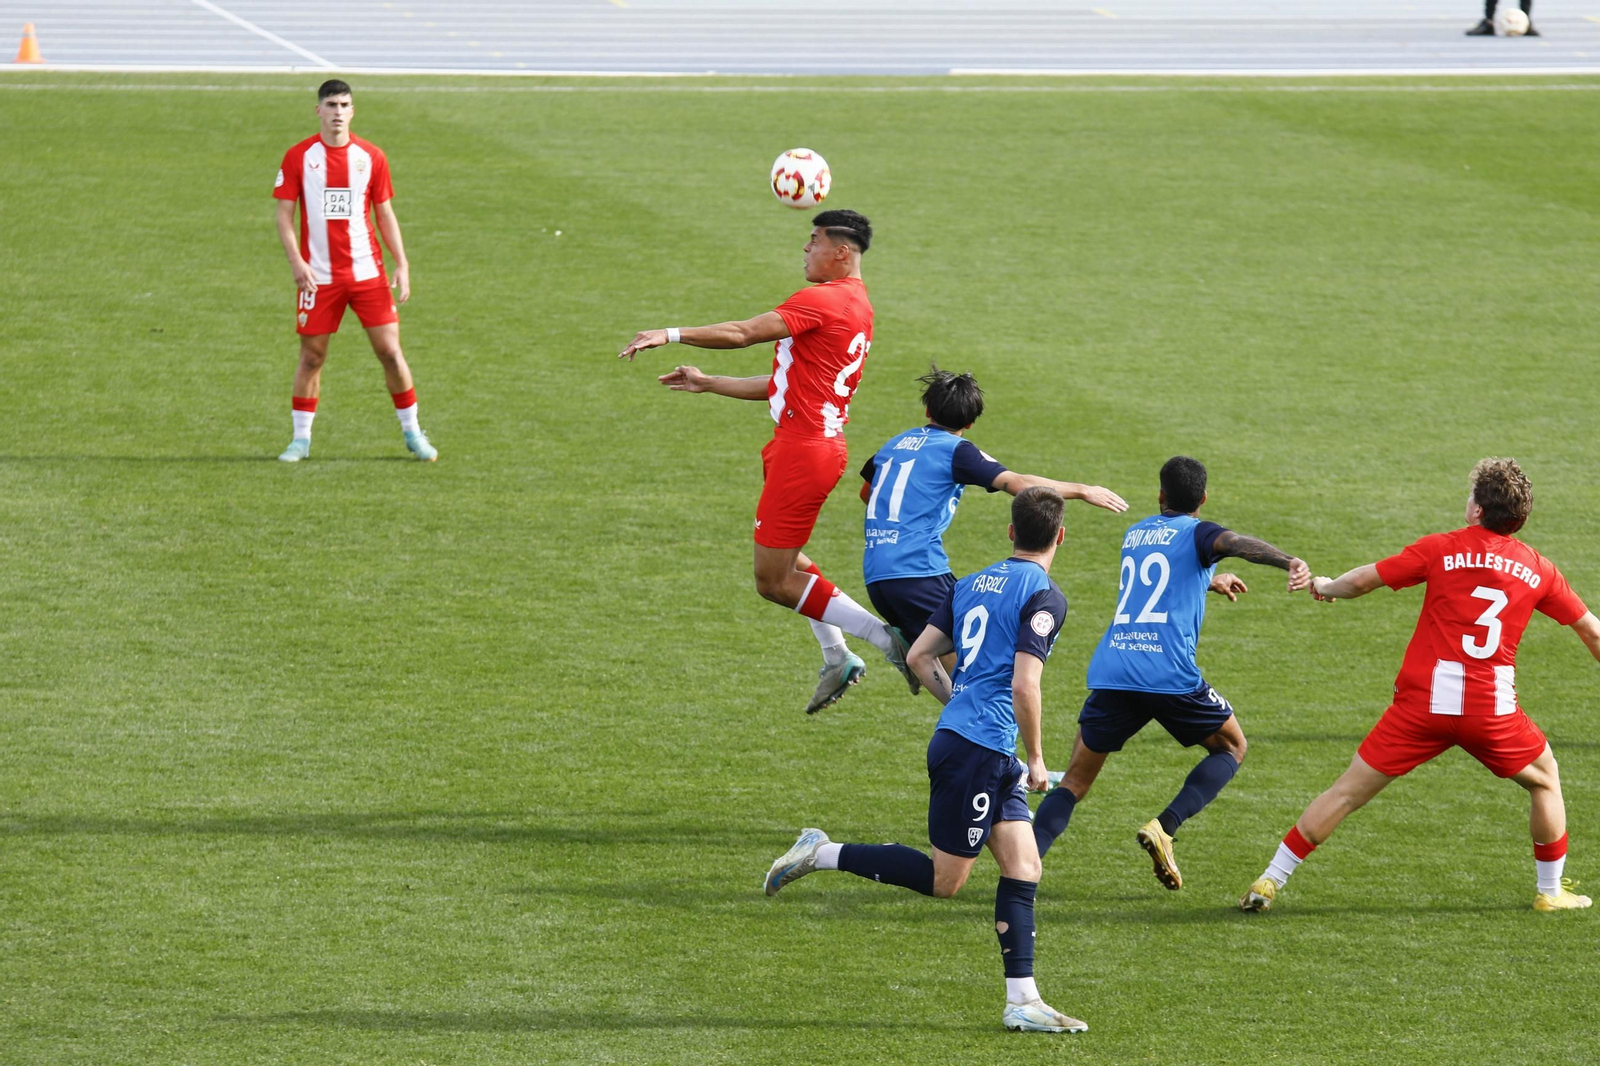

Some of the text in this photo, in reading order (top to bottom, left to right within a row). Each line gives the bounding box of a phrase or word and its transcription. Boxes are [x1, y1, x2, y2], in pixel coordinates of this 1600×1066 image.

[330, 194, 345, 202] DA
[330, 205, 345, 213] ZN
[299, 290, 315, 310] 19
[867, 457, 916, 522] 11
[1113, 552, 1171, 626] 22
[1443, 552, 1541, 589] BALLESTERO
[957, 604, 990, 672] 9
[1462, 585, 1509, 660] 3
[972, 792, 990, 822] 9
